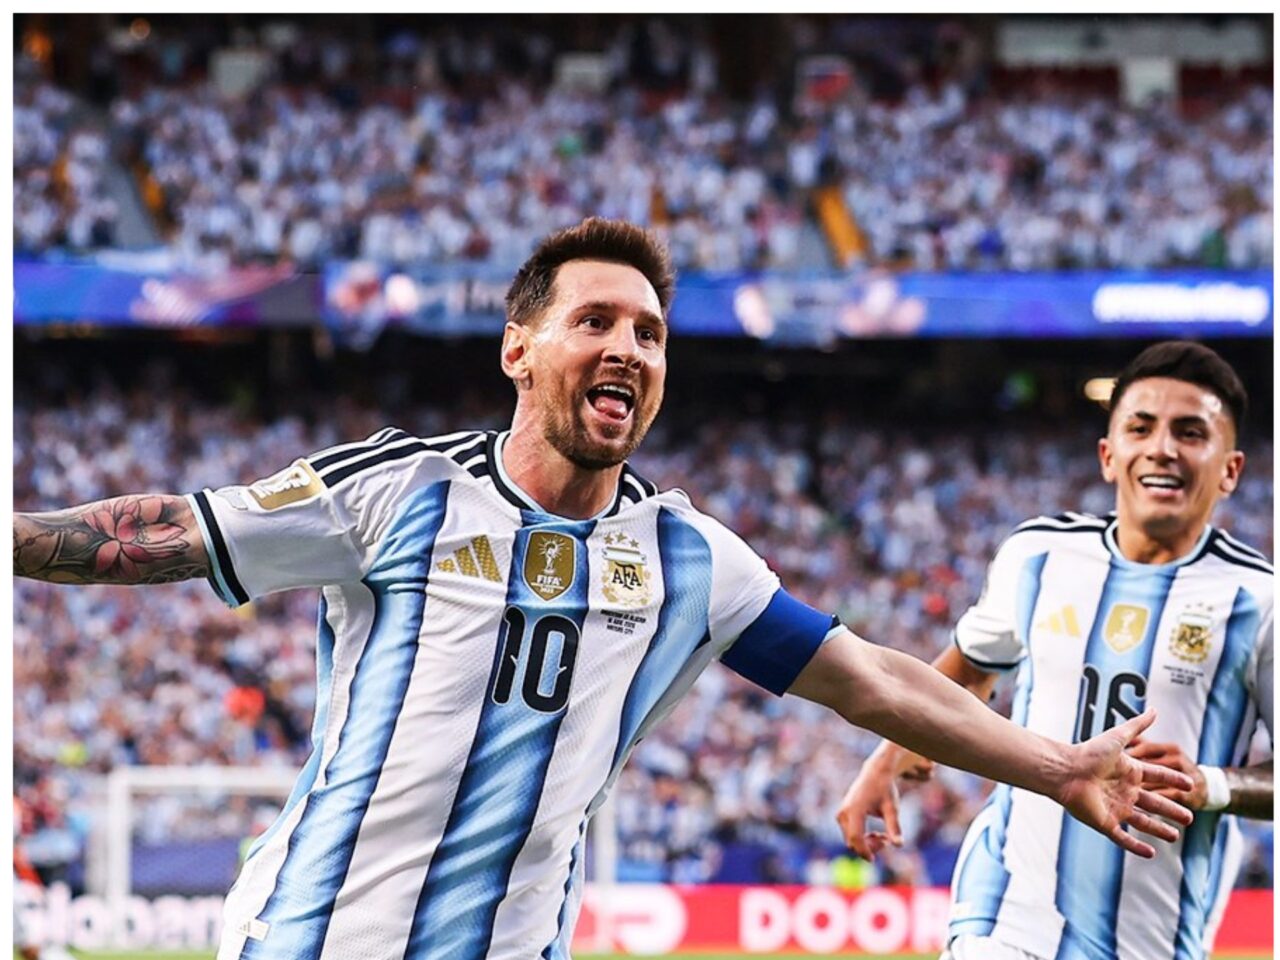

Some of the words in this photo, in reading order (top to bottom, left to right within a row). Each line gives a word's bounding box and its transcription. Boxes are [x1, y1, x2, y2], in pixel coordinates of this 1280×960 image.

[536, 574, 560, 586] FIFA
[612, 561, 642, 591] AFA
[492, 604, 581, 713] 10
[739, 886, 952, 954] DOOR
